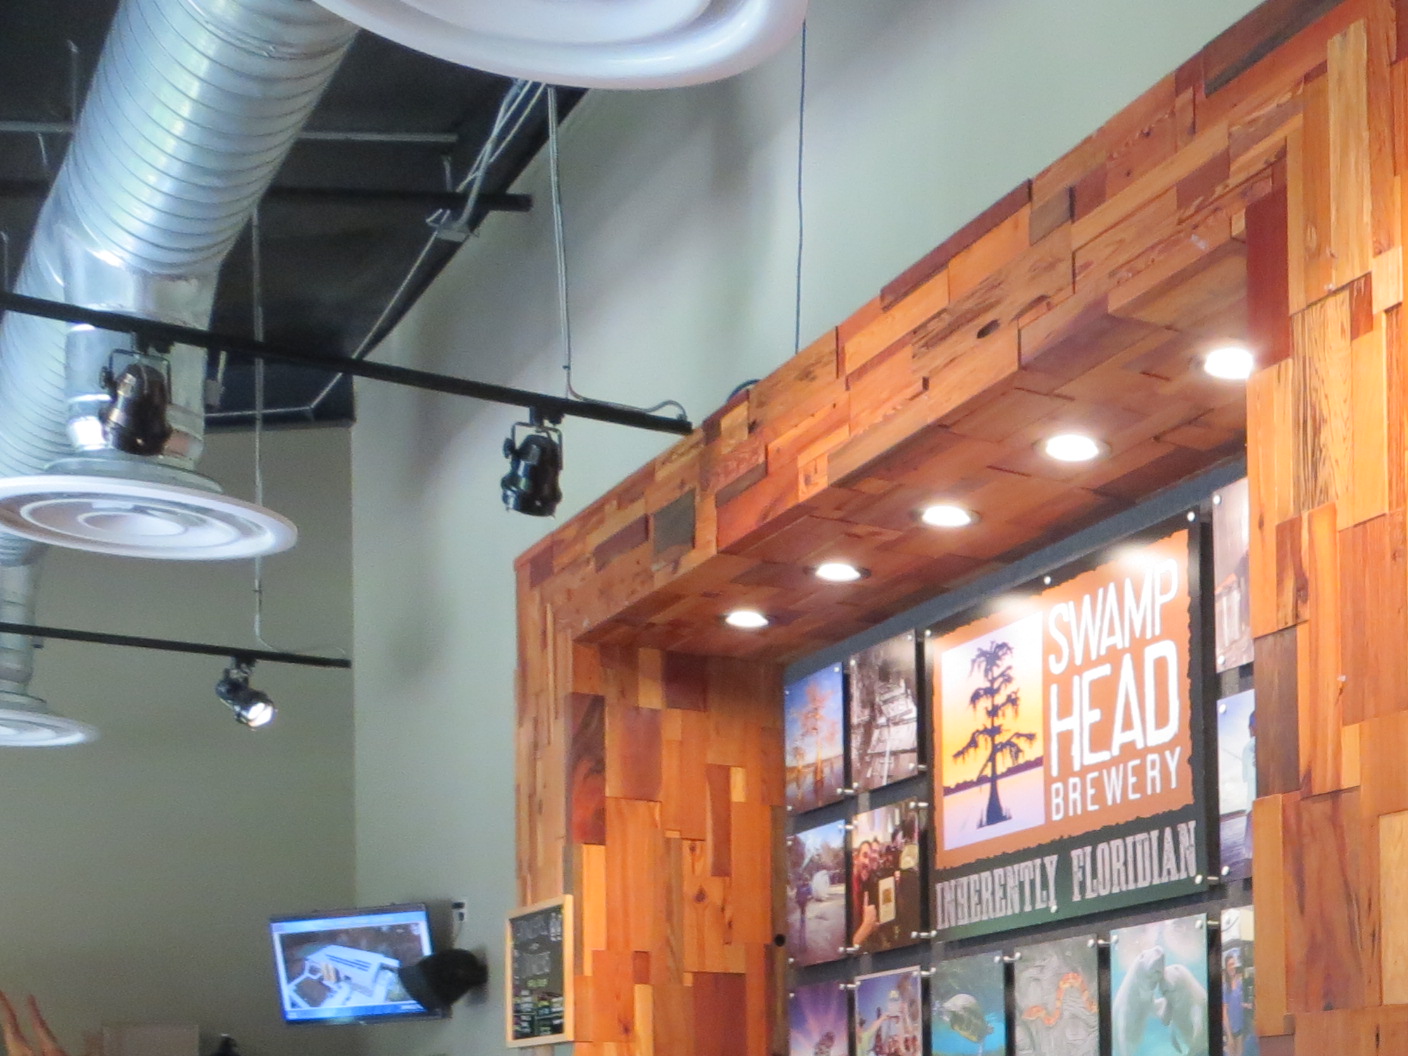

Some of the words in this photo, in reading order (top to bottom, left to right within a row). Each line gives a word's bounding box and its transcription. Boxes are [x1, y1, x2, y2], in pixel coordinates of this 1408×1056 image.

[1048, 557, 1179, 675] SWAMP
[1049, 639, 1180, 777] HEAD
[1050, 745, 1183, 822] BREWERY
[935, 854, 1059, 930] INHERENTLY
[1071, 820, 1198, 902] FLORIDIAN
